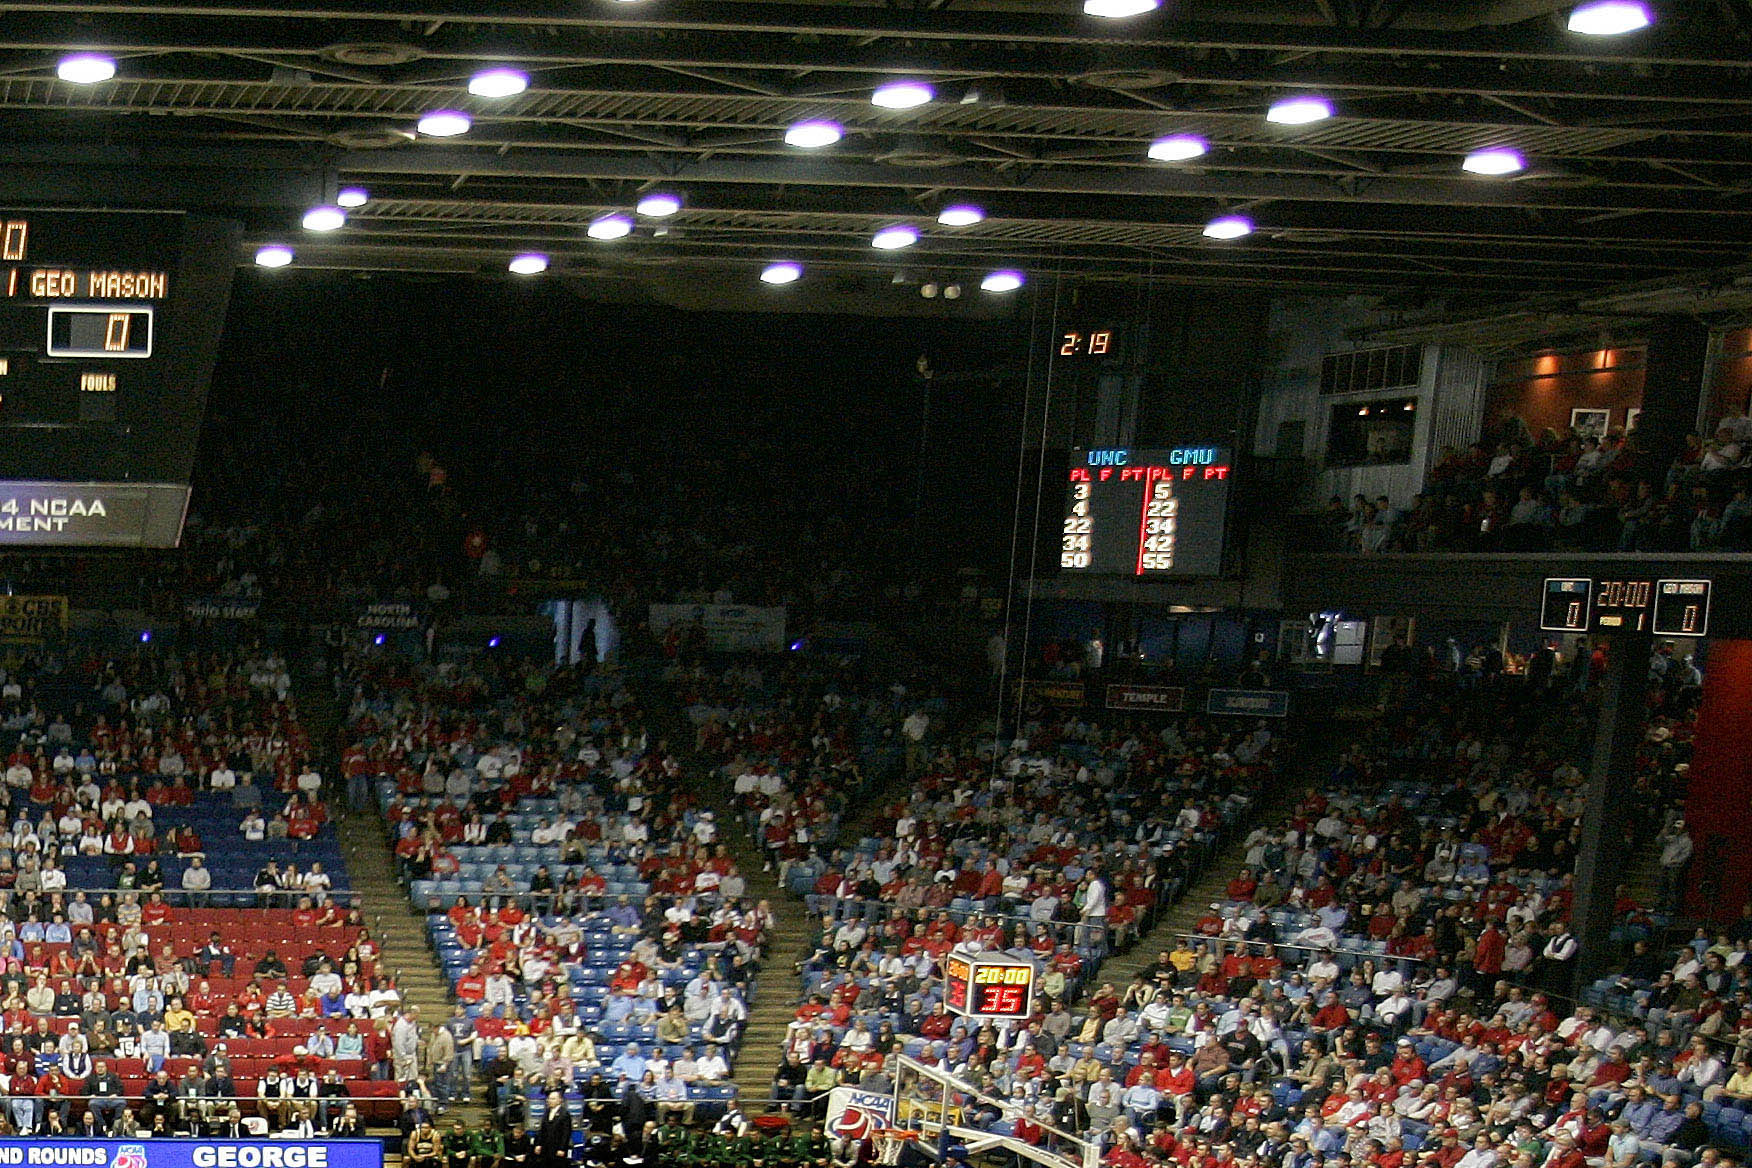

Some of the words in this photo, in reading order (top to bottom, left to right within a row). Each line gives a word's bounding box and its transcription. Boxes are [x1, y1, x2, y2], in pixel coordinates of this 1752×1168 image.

[30, 270, 77, 298] GEO
[88, 271, 165, 299] MASON
[105, 313, 130, 352] 0
[1061, 332, 1109, 355] 2:19
[81, 374, 115, 392] FOULS
[1170, 449, 1213, 465] GMU
[1073, 484, 1089, 500] 3
[1155, 483, 1171, 500] 5
[30, 498, 107, 517] NCAA
[1072, 501, 1088, 517] 4
[1147, 501, 1177, 517] 22
[1064, 518, 1092, 534] 22
[1146, 517, 1175, 534] 34
[1063, 535, 1091, 551] 34
[1144, 535, 1174, 552] 42
[1061, 552, 1091, 568] 50
[1142, 552, 1173, 570] 55
[1597, 581, 1650, 608] 20:00
[975, 967, 1029, 985] 20:00
[981, 987, 1021, 1012] 35
[28, 1147, 107, 1165] ROUNDS
[192, 1146, 328, 1168] GEORGE
